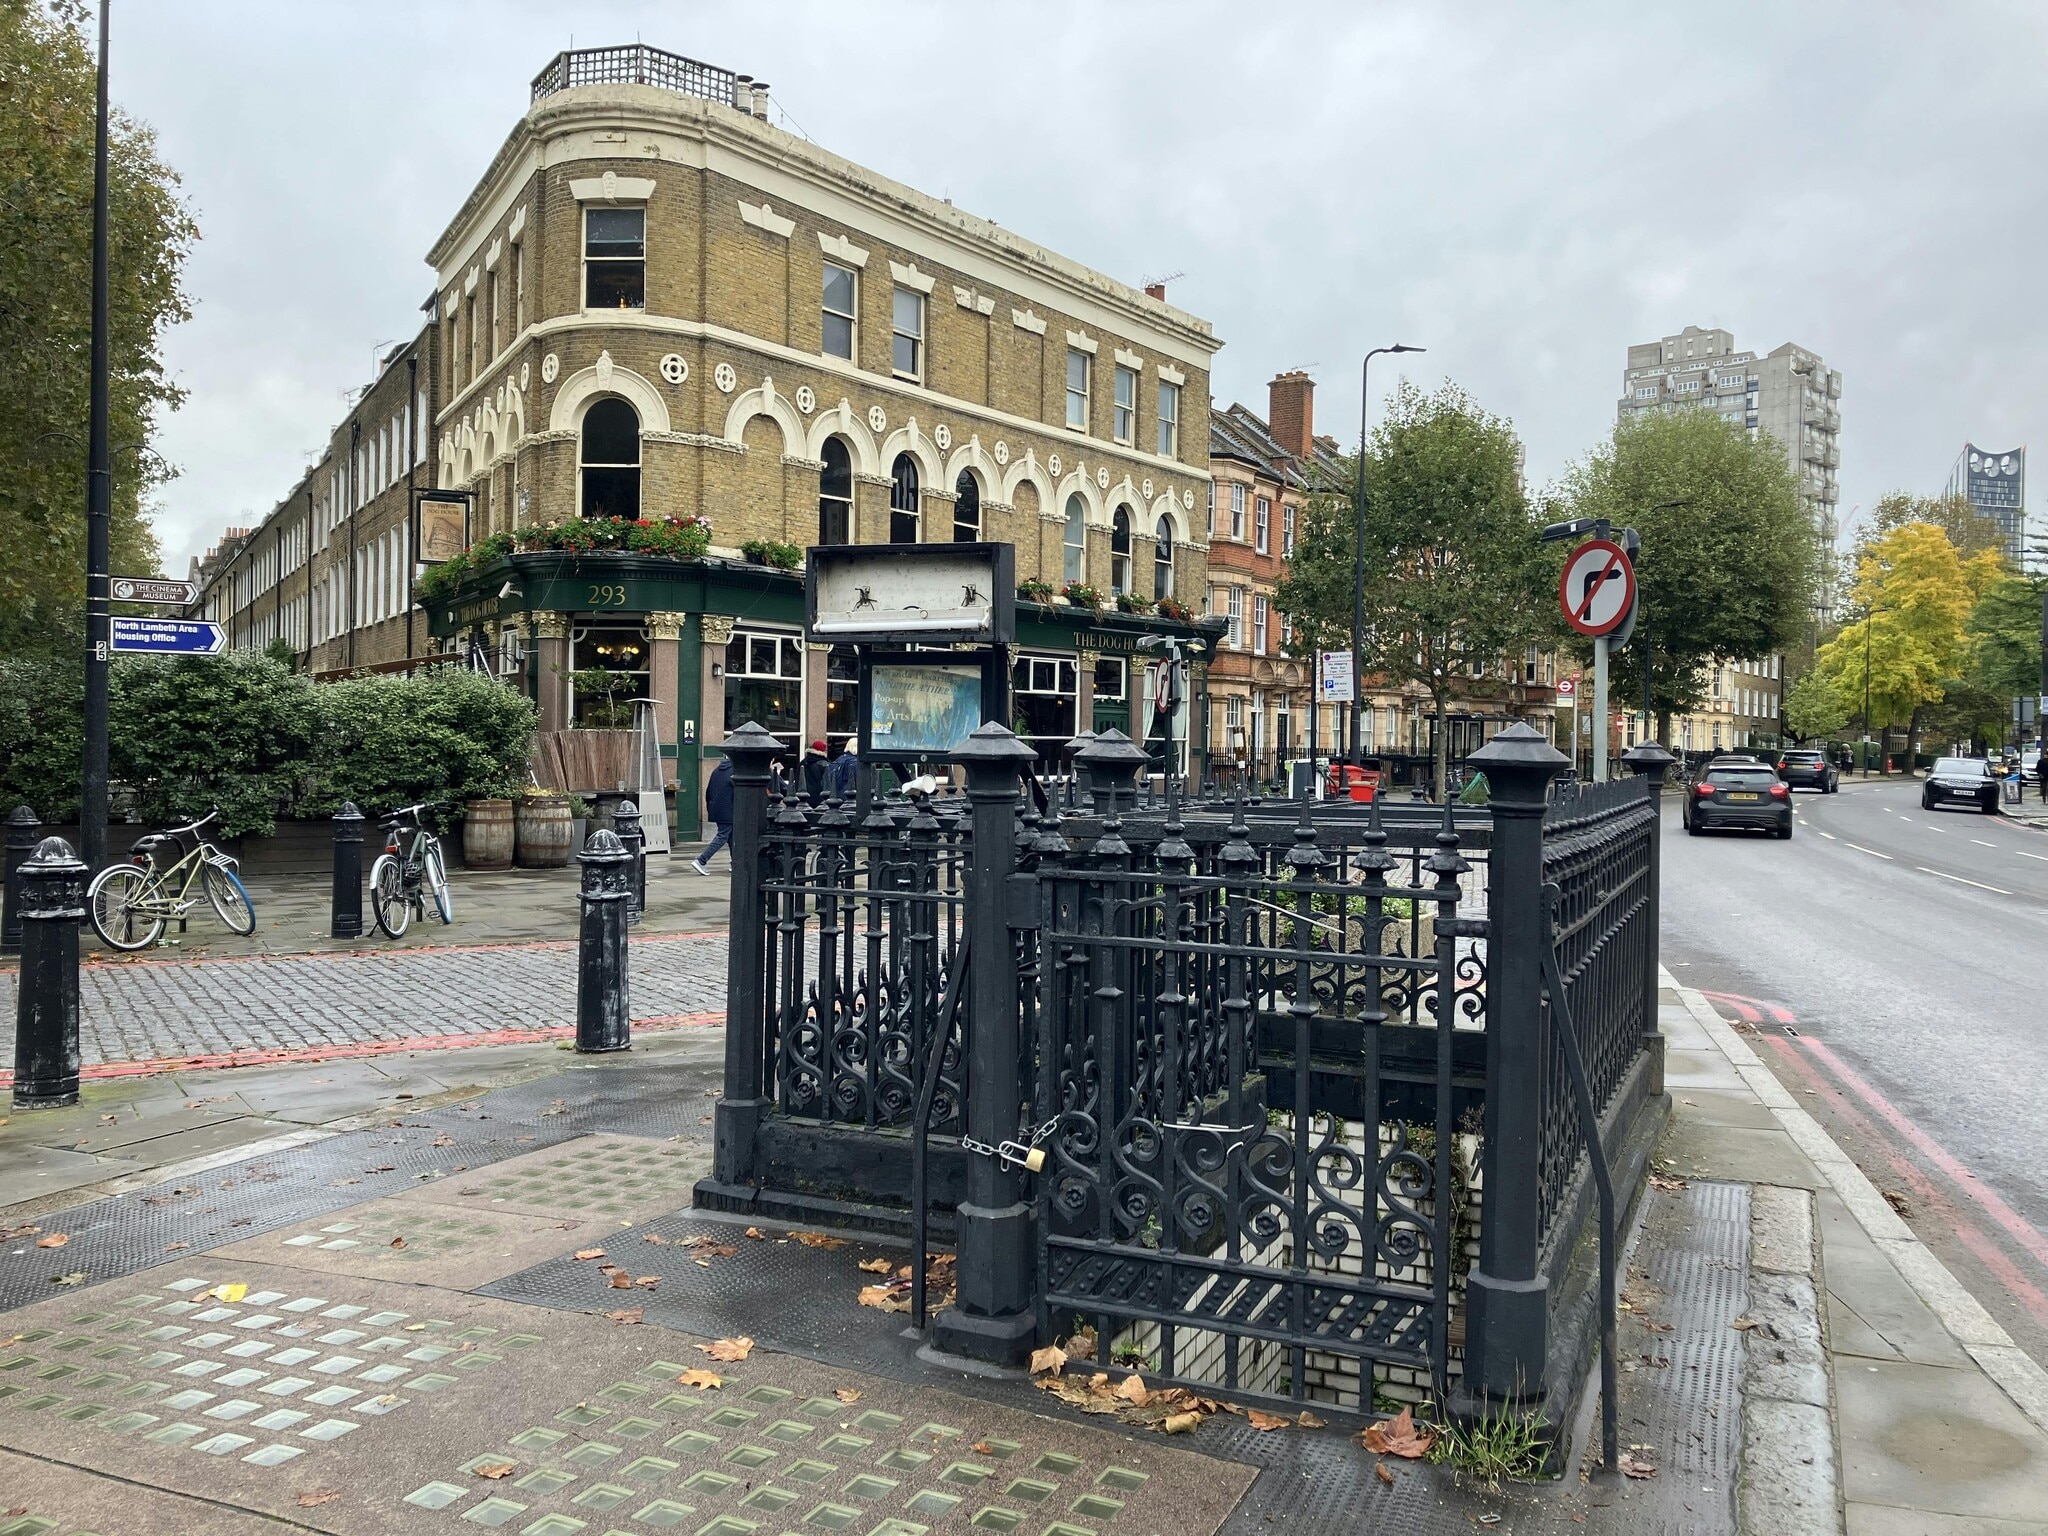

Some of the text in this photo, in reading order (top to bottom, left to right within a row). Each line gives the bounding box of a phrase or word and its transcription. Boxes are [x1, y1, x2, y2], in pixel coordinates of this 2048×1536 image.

[135, 584, 182, 593] THE CINEMA
[142, 592, 177, 600] MUSEUM
[587, 585, 626, 606] 293
[114, 621, 198, 633] North Lambeth Area
[114, 631, 177, 643] Housing Office
[1073, 631, 1096, 647] THE
[1098, 633, 1121, 649] DOG
[874, 693, 905, 705] Pop-up
[874, 709, 885, 719] @
